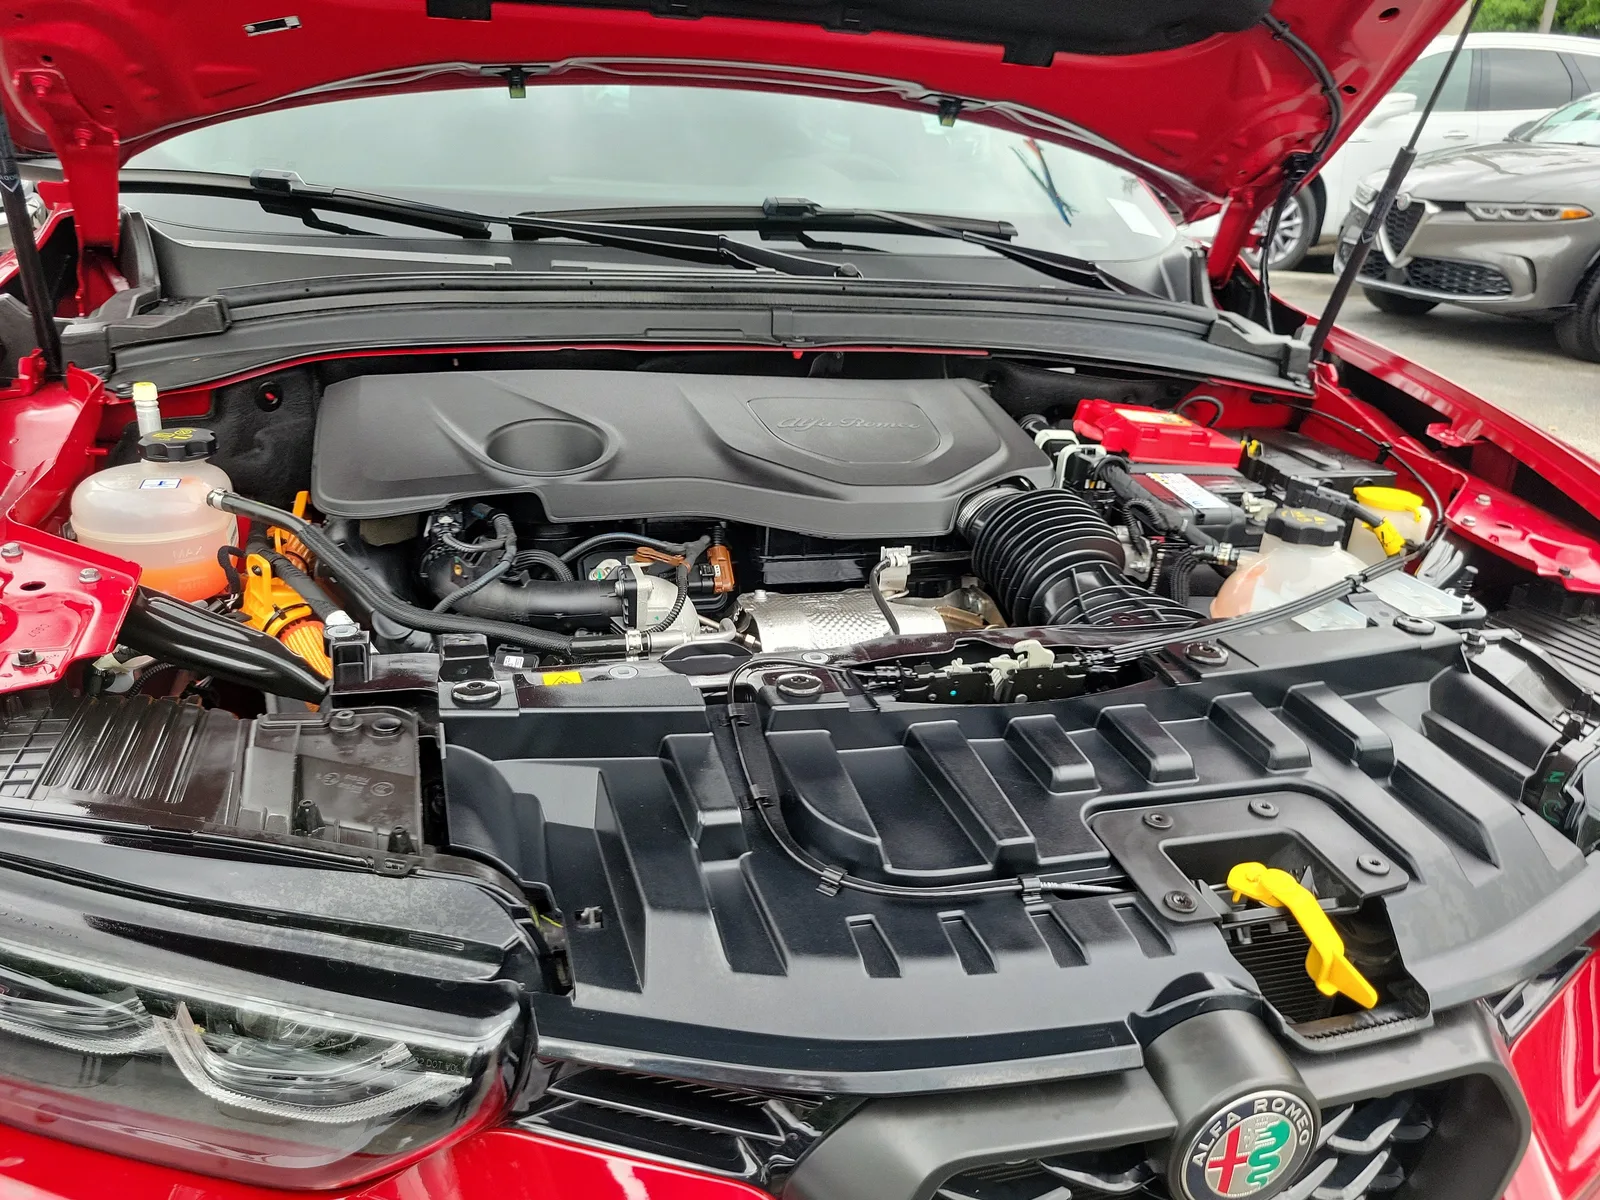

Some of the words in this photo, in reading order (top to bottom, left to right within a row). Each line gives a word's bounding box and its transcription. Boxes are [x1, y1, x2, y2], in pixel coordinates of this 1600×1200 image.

[777, 415, 835, 432] Alfa
[838, 417, 921, 430] Romeo
[172, 545, 203, 560] MAX
[426, 1058, 443, 1069] DOT
[1192, 1111, 1242, 1167] ALFA
[1253, 1097, 1310, 1146] ROMEO
